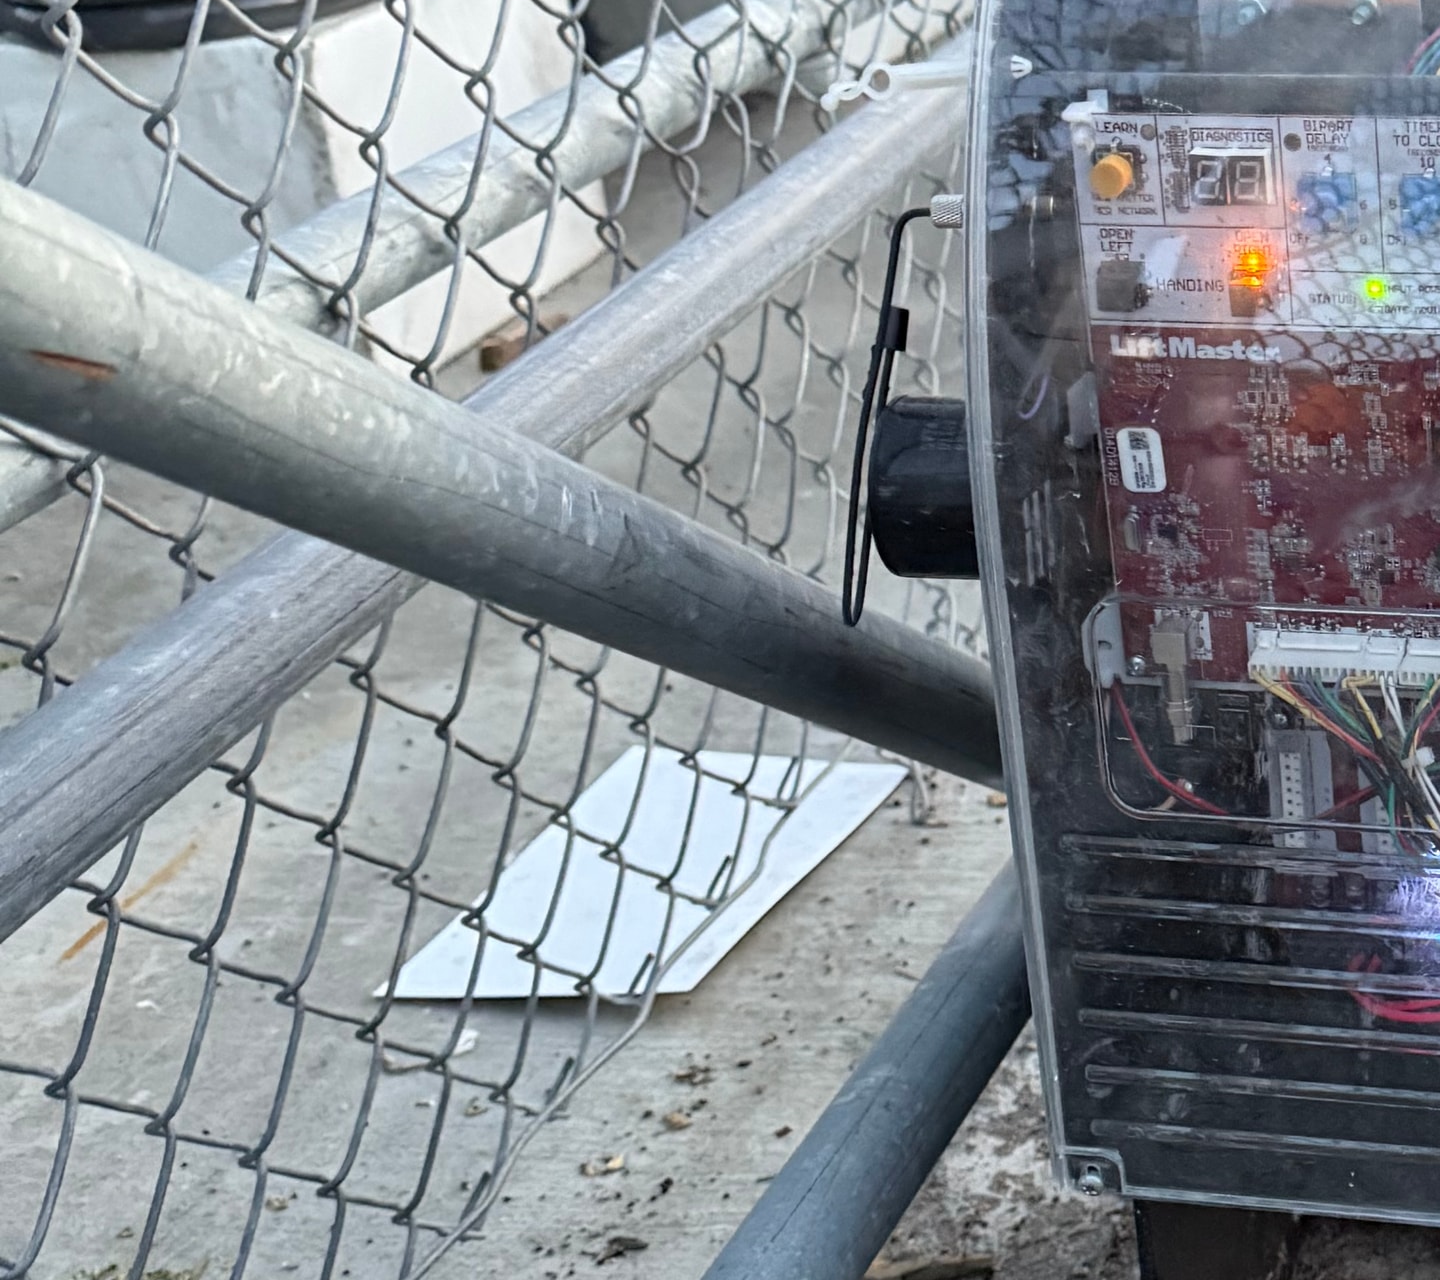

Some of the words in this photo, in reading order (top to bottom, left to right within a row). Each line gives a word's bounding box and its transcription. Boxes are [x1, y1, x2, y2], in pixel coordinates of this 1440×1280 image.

[1095, 122, 1138, 134] LEARN
[1303, 120, 1353, 132] BIPART
[1191, 130, 1273, 142] DIAGNOSTICS
[1305, 133, 1349, 144] DELAY
[1393, 135, 1410, 146] TO
[1420, 157, 1435, 168] 10
[1100, 228, 1133, 240] OPEN
[1101, 241, 1133, 253] LEFT
[1155, 278, 1225, 293] HANDING
[1110, 333, 1283, 362] LiftMaster
